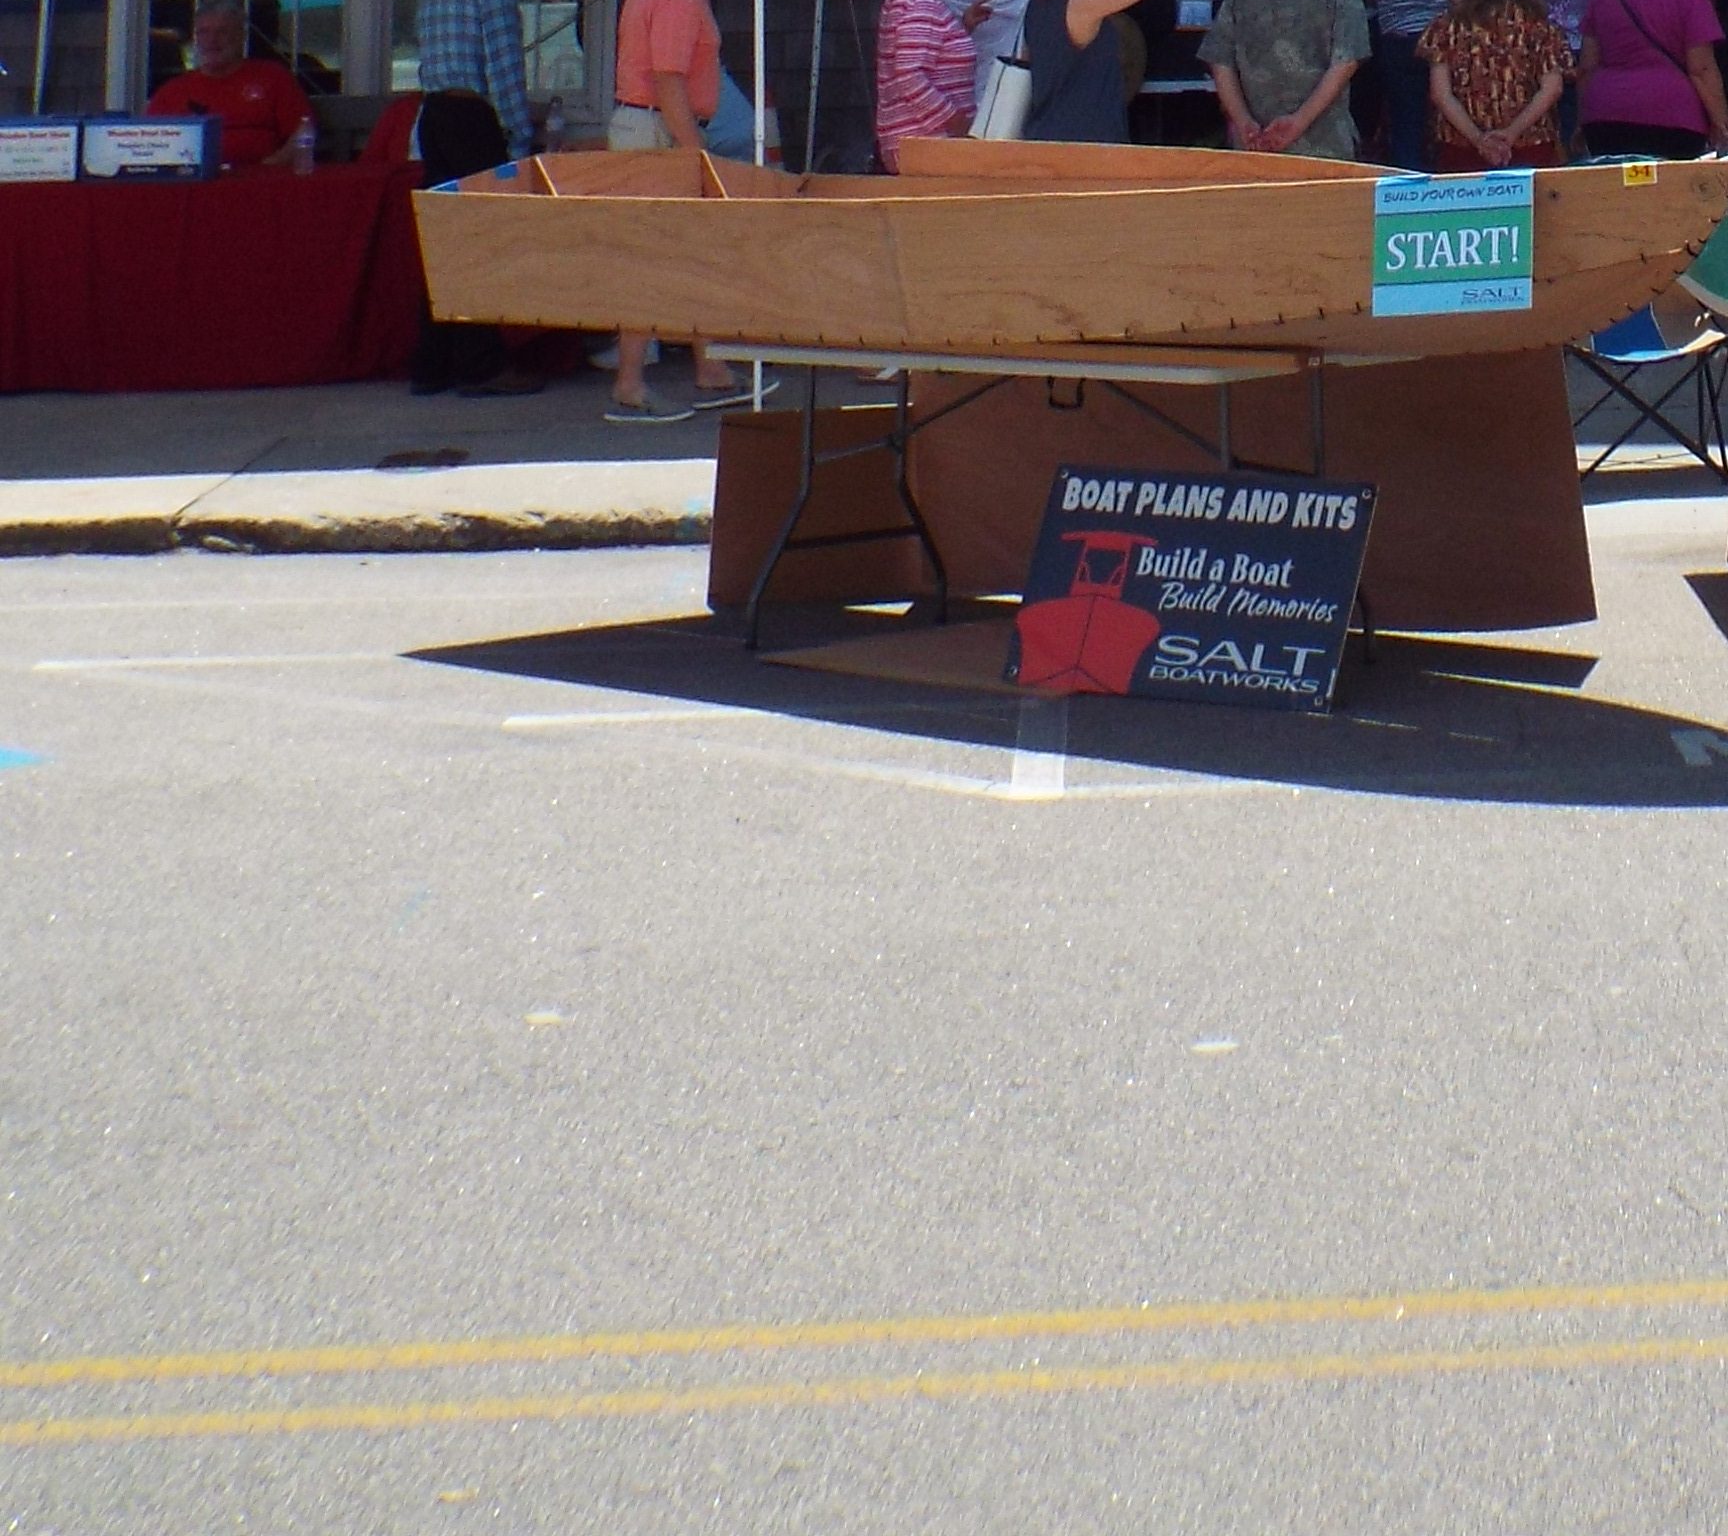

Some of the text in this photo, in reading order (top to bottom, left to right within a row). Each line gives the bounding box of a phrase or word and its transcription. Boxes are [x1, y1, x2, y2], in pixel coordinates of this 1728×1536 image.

[1384, 191, 1419, 203] BUILD
[1420, 189, 1454, 202] YOUR
[1457, 187, 1484, 199] OWN
[1386, 226, 1520, 272] START!
[1462, 287, 1523, 298] SALT
[1062, 477, 1358, 530] BOAT PLANS AND KITS
[1136, 546, 1295, 588] Build a Boat
[1158, 581, 1338, 623] Build Memories
[1155, 634, 1326, 677] SALT
[1150, 665, 1321, 694] BOATWORKS
